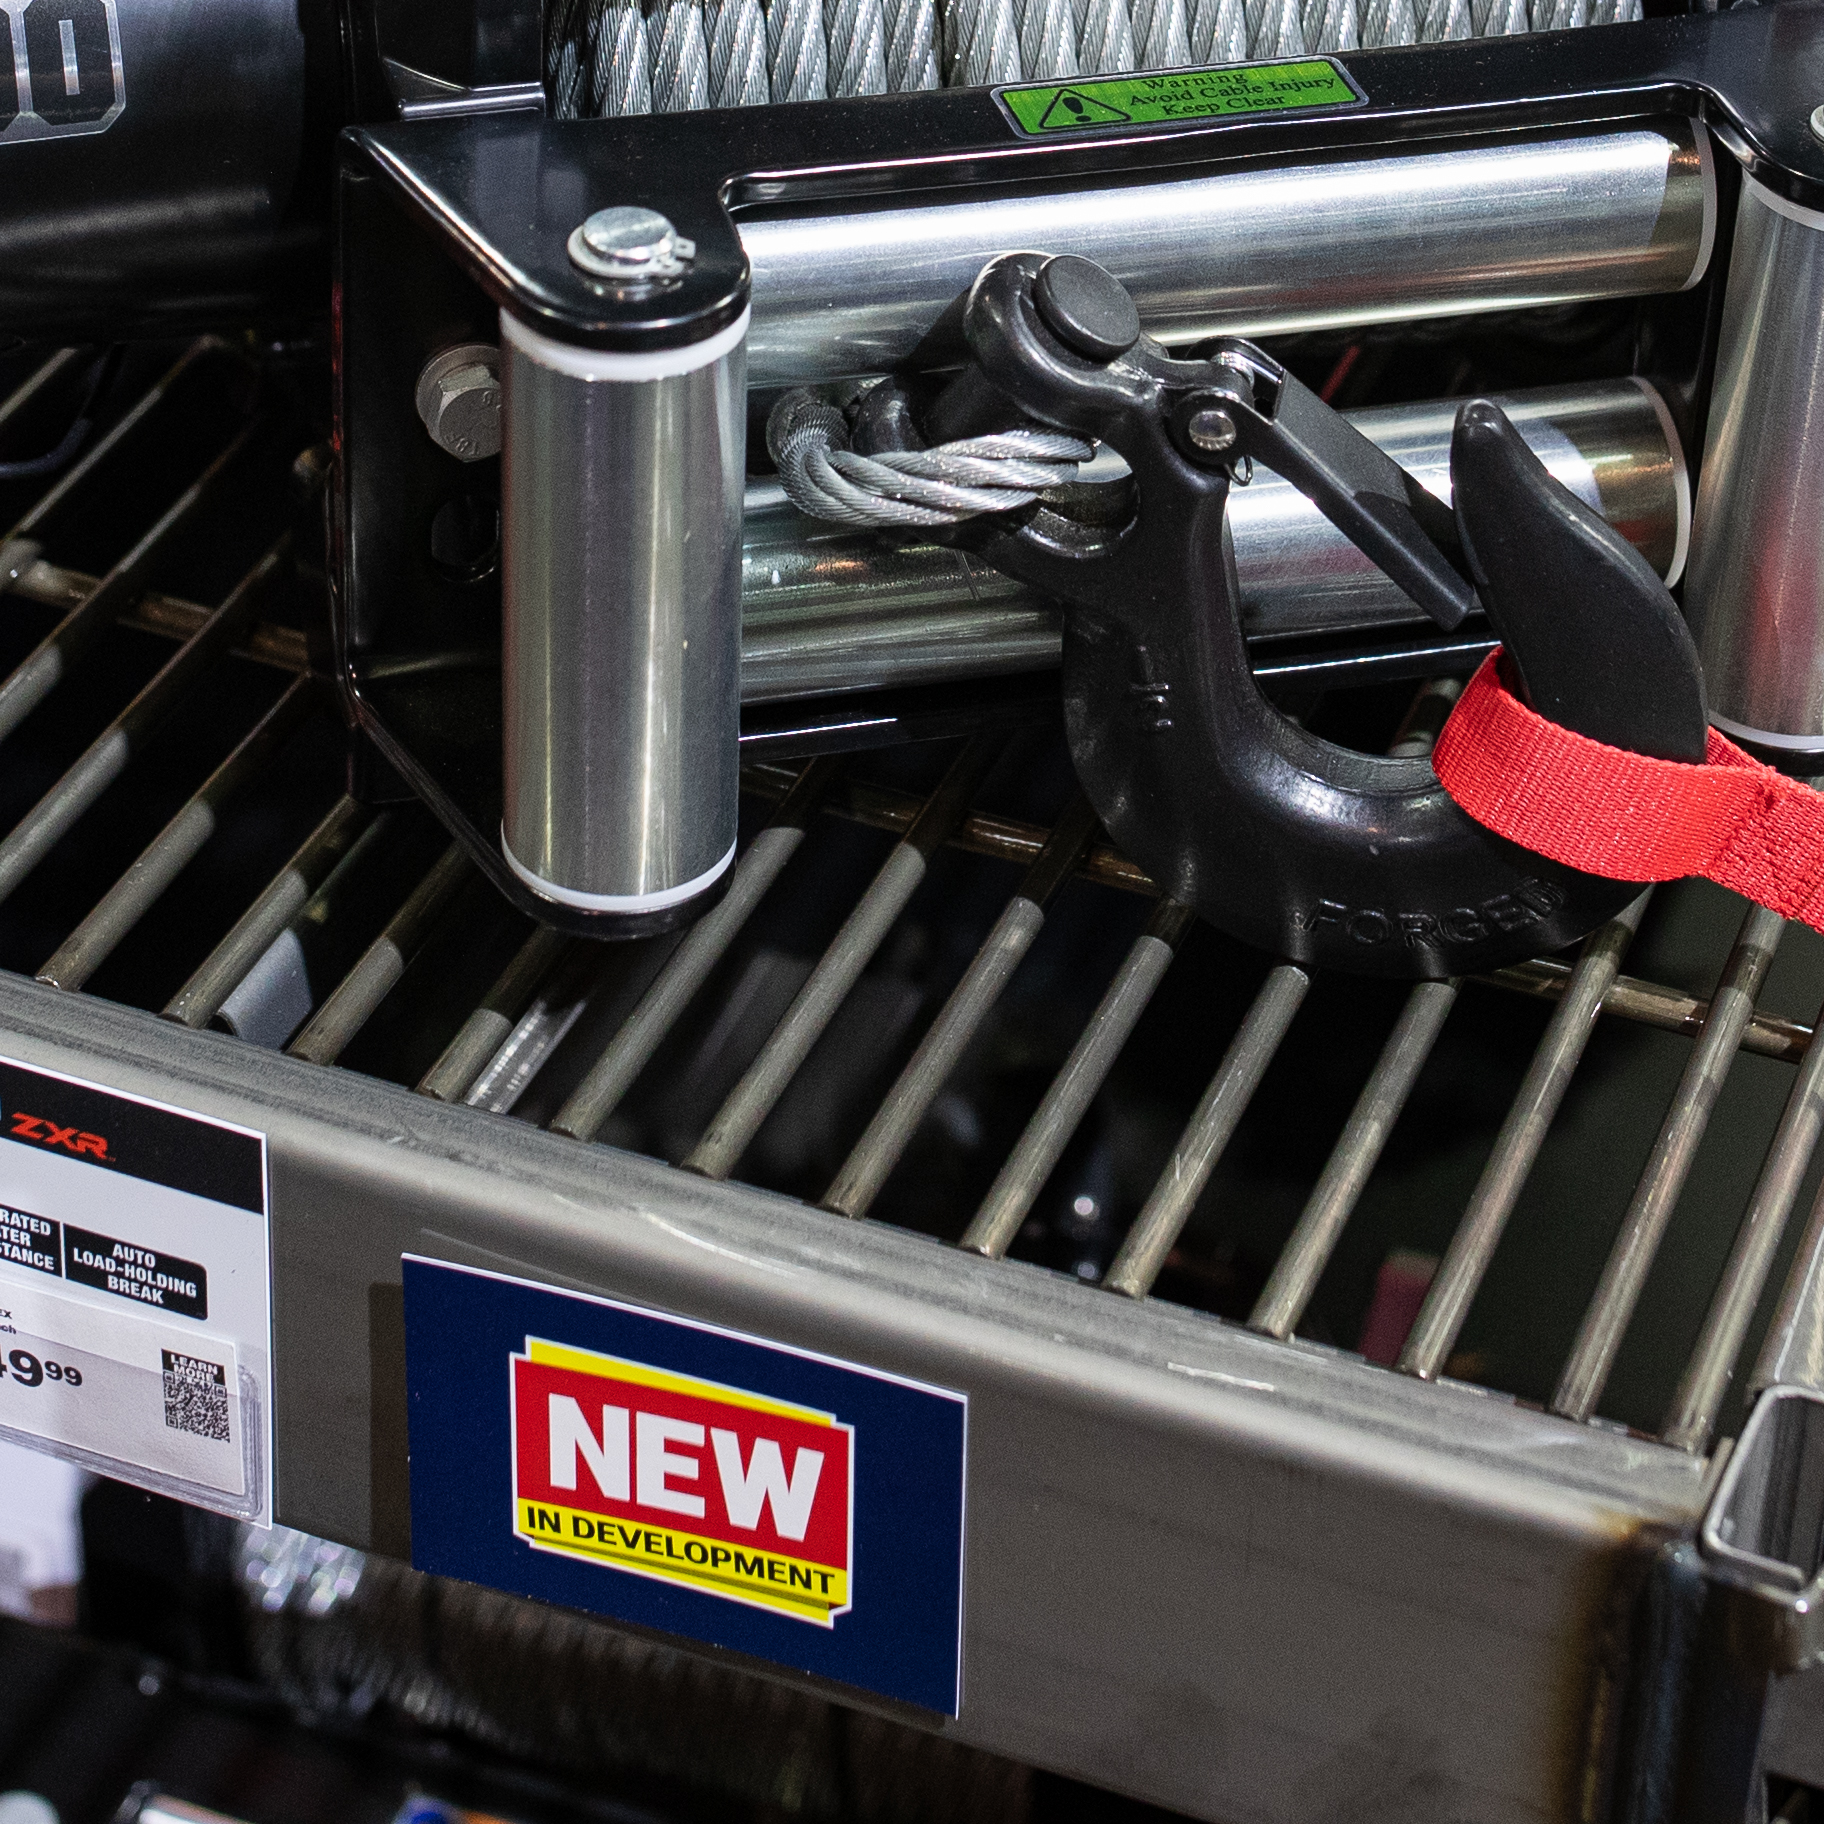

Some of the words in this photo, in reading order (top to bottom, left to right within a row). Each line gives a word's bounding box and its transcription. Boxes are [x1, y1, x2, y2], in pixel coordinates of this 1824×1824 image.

[1129, 89, 1192, 106] Avoid
[1192, 81, 1264, 101] Cable
[1270, 76, 1337, 95] Injury
[1141, 72, 1245, 91] Warning
[1161, 99, 1222, 117] Keep
[1224, 93, 1286, 111] Clear
[1302, 878, 1568, 949] FORGED
[10, 1112, 110, 1160] ZXR
[112, 1243, 156, 1268] AUTO
[73, 1248, 198, 1298] LOAD-HOLDING
[107, 1274, 165, 1305] BREAK
[170, 1354, 218, 1376] LEARN
[173, 1364, 214, 1383] MORE
[548, 1392, 825, 1542] NEW
[526, 1506, 562, 1534] IN
[571, 1515, 835, 1595] DEVELOPMENT
